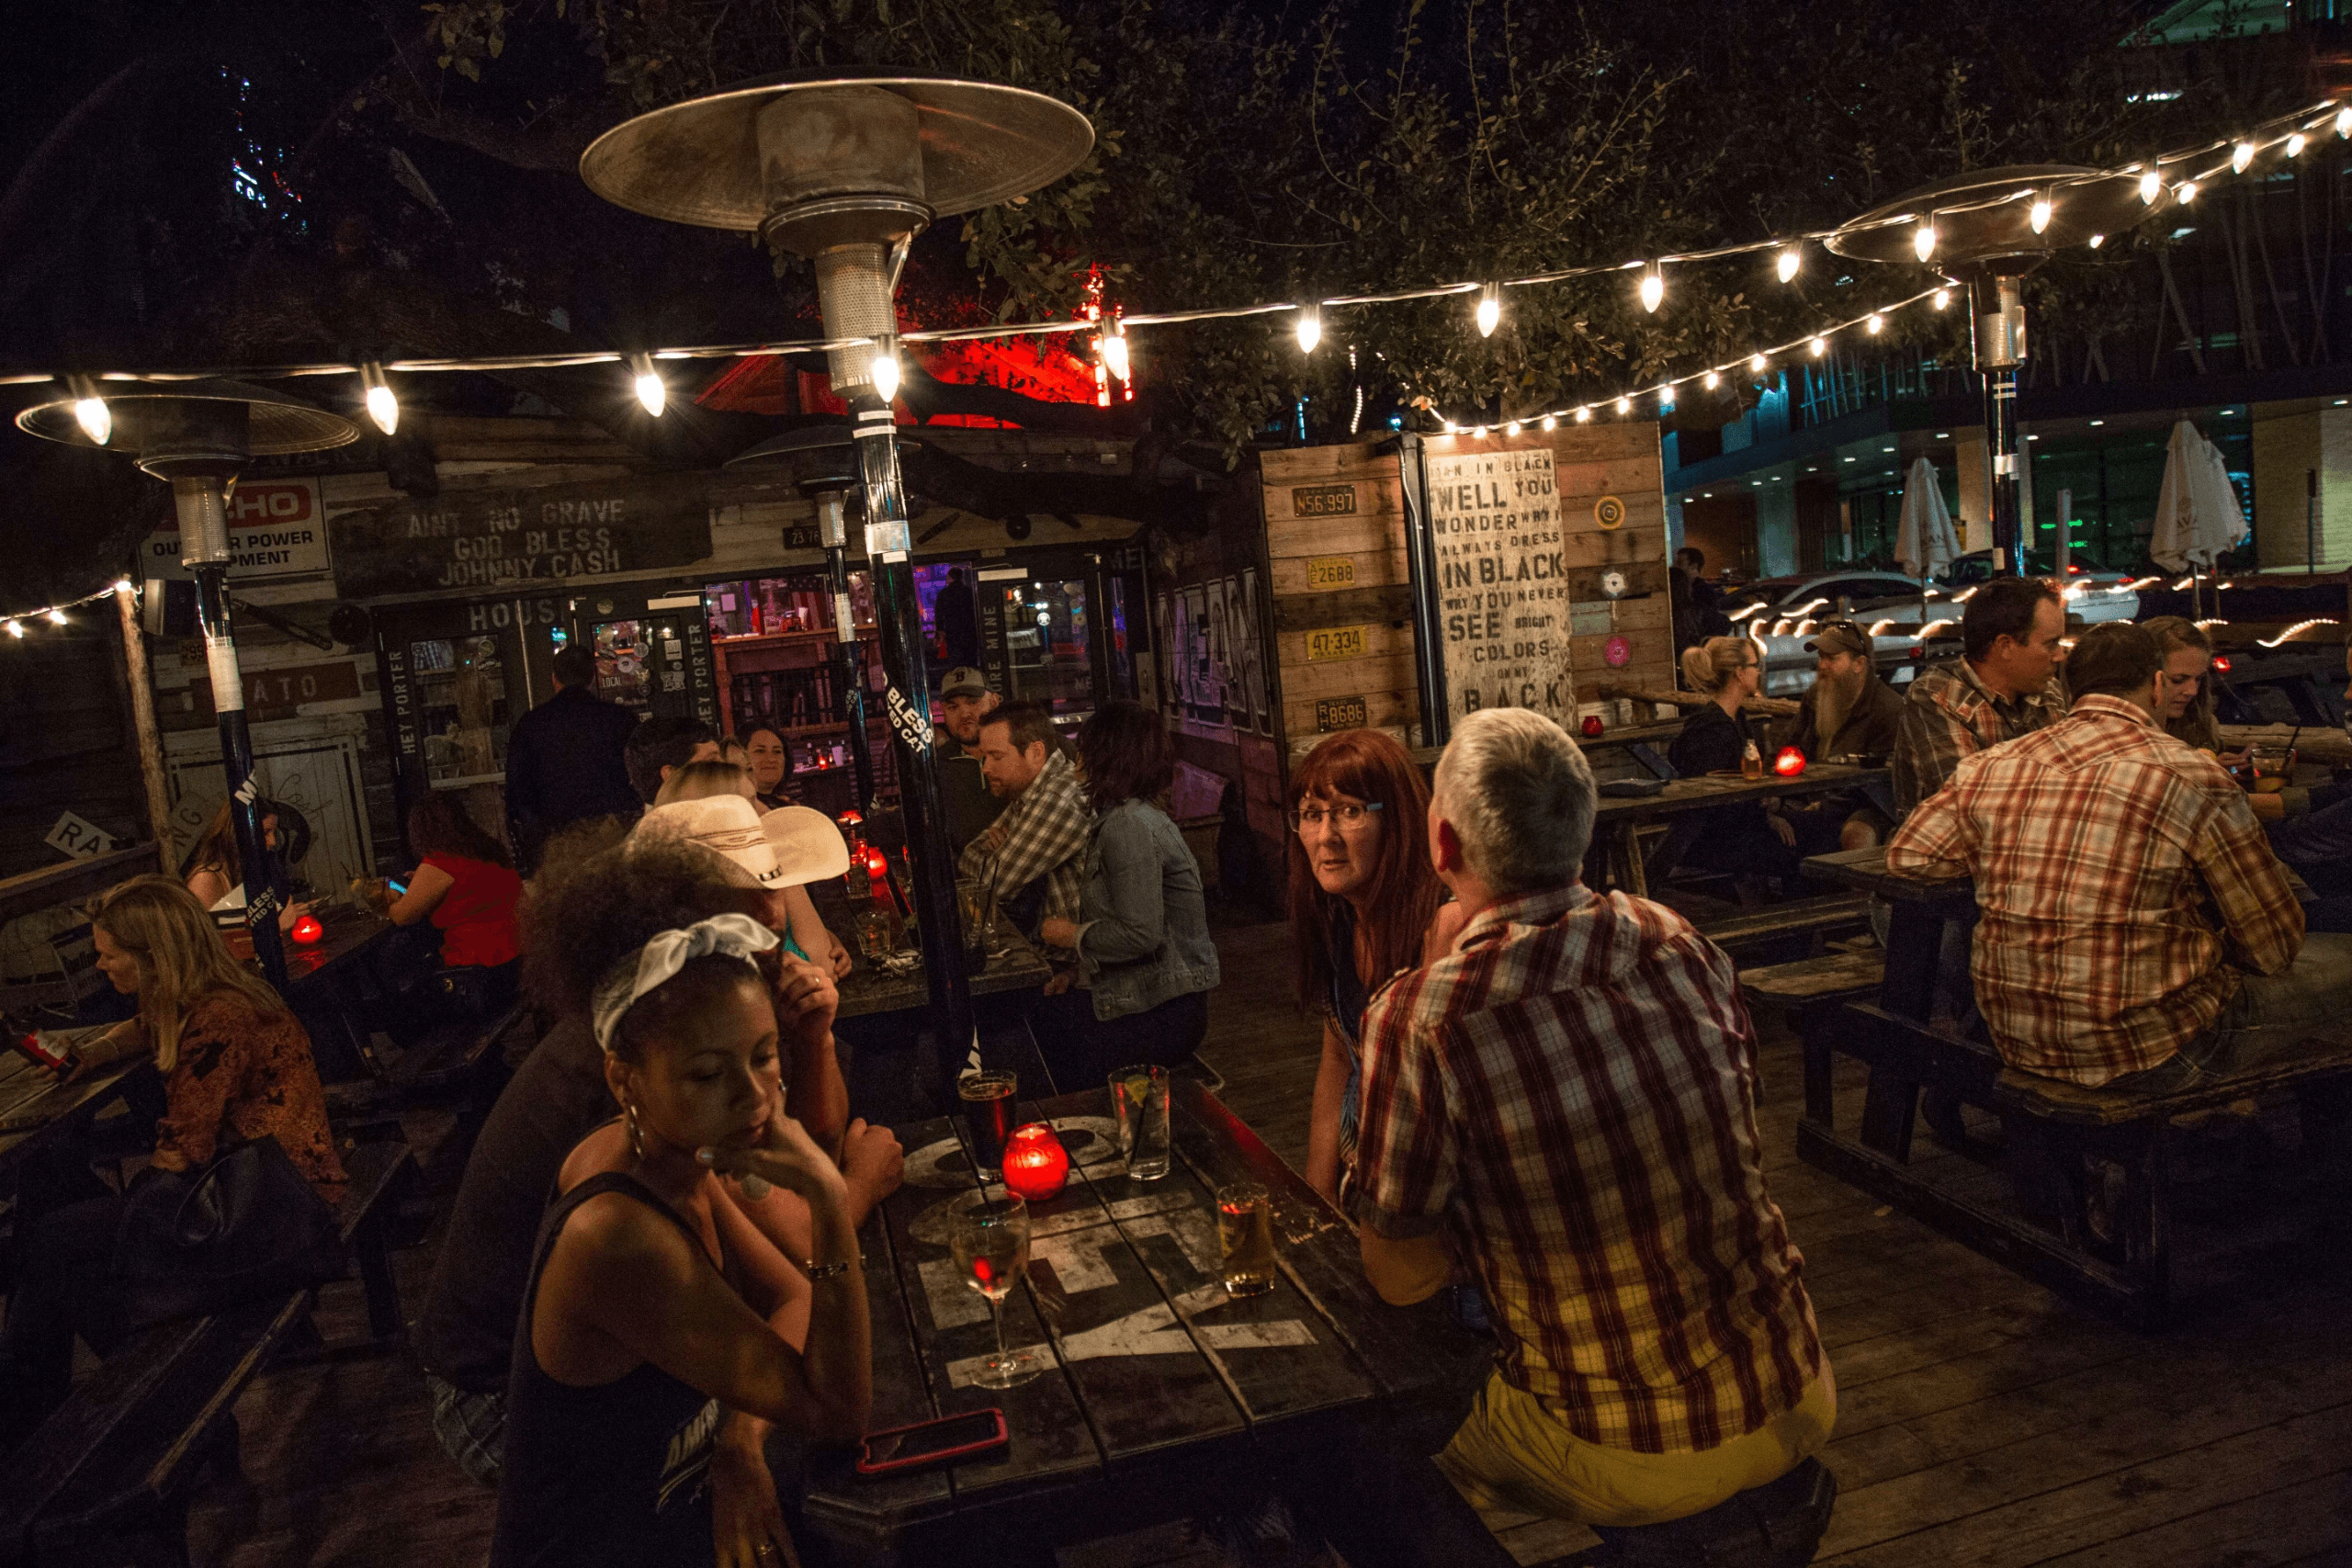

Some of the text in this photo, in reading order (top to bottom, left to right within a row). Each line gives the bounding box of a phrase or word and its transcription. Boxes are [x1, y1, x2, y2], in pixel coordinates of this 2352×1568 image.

[1504, 456, 1551, 472] BLACK
[1437, 479, 1552, 511] WELL YOU
[408, 499, 625, 537] AINT NO GRAVE
[1434, 513, 1517, 534] WONDER
[1521, 508, 1549, 523] WHY
[247, 530, 313, 548] POWER
[454, 527, 611, 560] GOD BLESS
[1441, 532, 1559, 556] ALWAYS DRESS
[438, 549, 620, 586] JOHNNY CASH
[1319, 565, 1353, 583] 2688
[1445, 552, 1565, 589] IN BLACK
[1446, 587, 1565, 610] WHY YOU NEVER
[983, 606, 999, 649] MINE
[1449, 612, 1552, 641] SEE BRIGHT
[1474, 640, 1549, 662] COLORS
[602, 676, 623, 688] LOCAL
[688, 624, 713, 725] HEY PORTER
[955, 671, 965, 682] B
[1498, 667, 1528, 679] ON MY
[389, 650, 415, 754] HEY PORTER
[1464, 682, 1562, 715] BACK
[887, 686, 934, 744] BLESS
[1329, 704, 1364, 725] 8686
[900, 728, 926, 753] CAT
